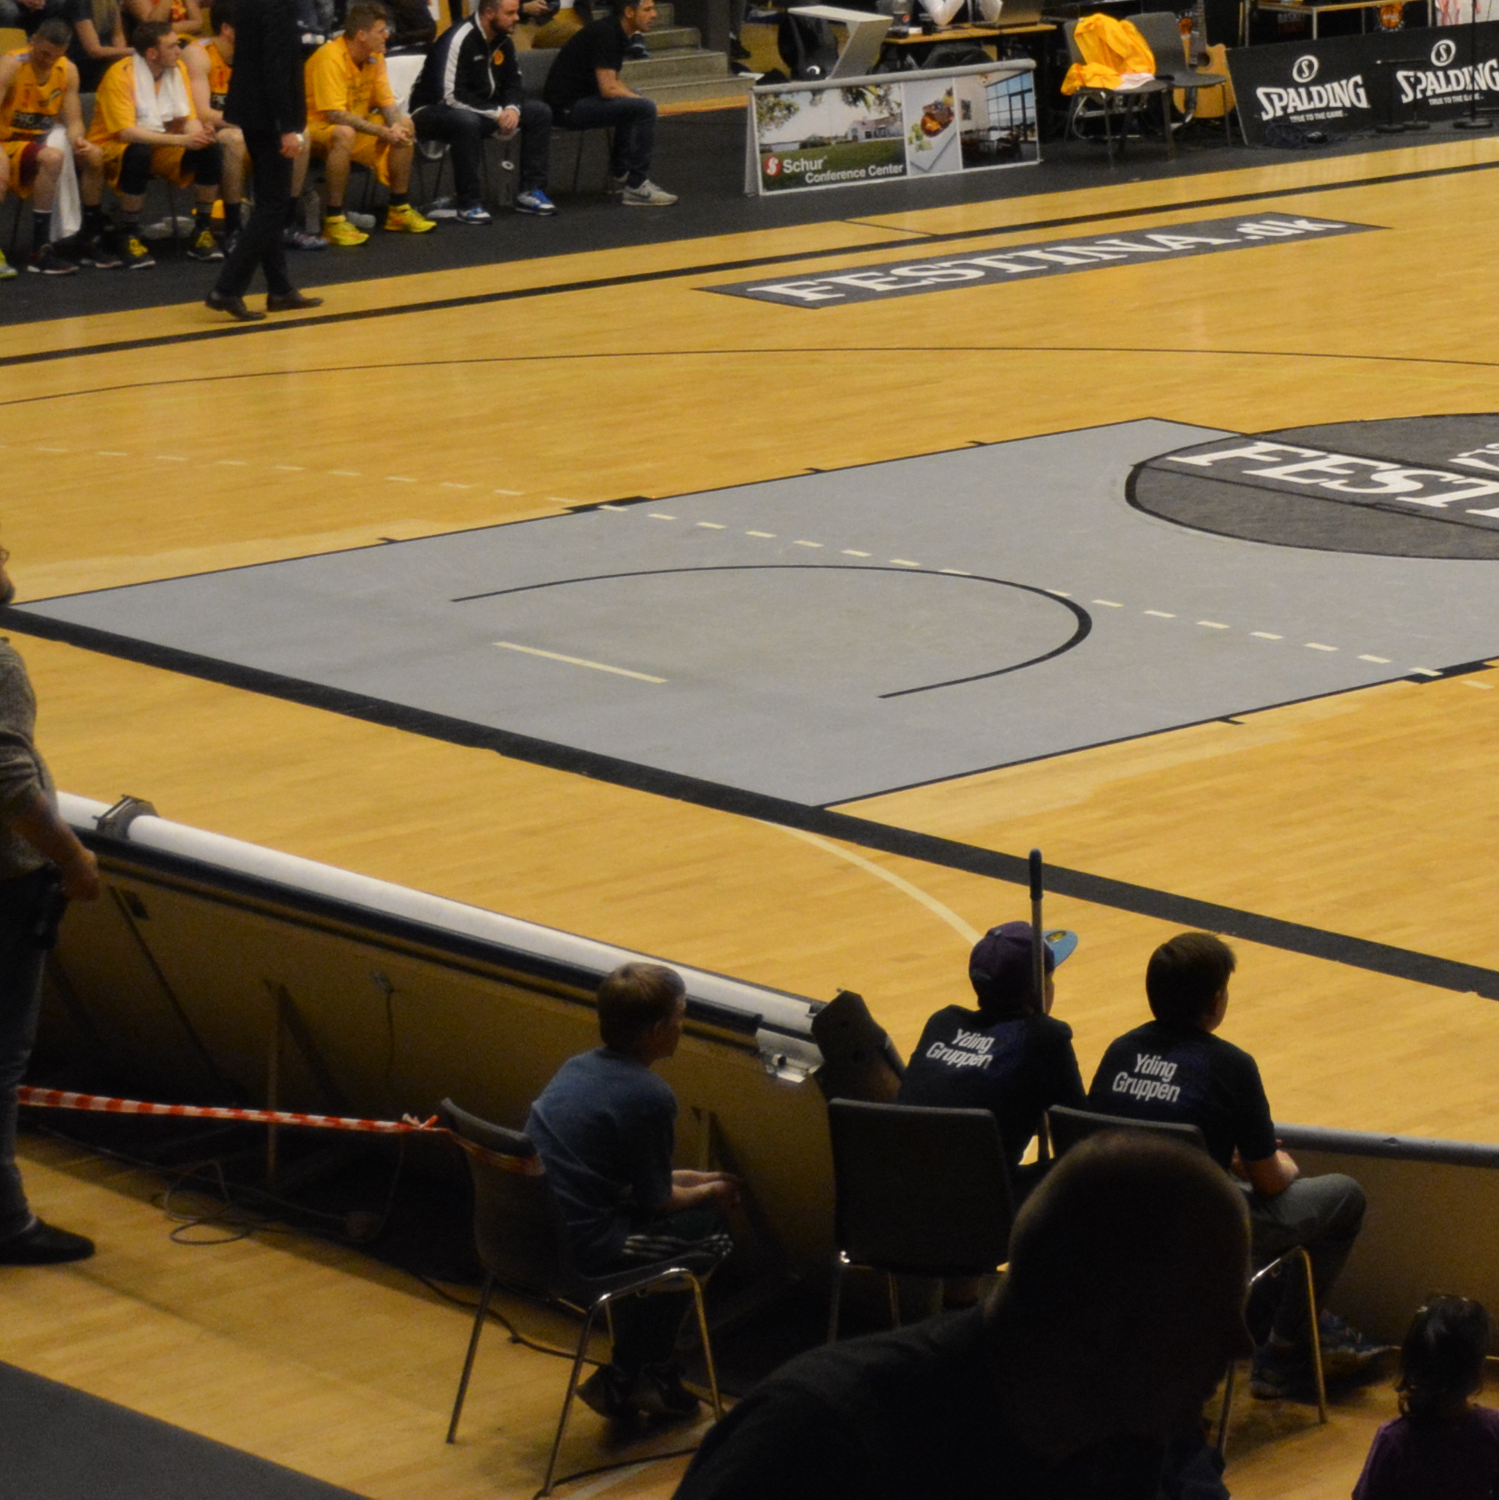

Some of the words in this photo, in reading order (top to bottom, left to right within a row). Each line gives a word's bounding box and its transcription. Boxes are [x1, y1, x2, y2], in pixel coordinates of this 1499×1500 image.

[1256, 74, 1371, 121] SPALDING
[783, 158, 825, 173] Schur
[805, 168, 866, 184] Conference
[868, 163, 904, 177] Center
[746, 217, 1348, 303] FESTINA.dk
[952, 1028, 995, 1053] Yding
[926, 1041, 993, 1071] Gruppen
[1134, 1053, 1178, 1083] Yding
[1112, 1071, 1181, 1103] Gruppen
